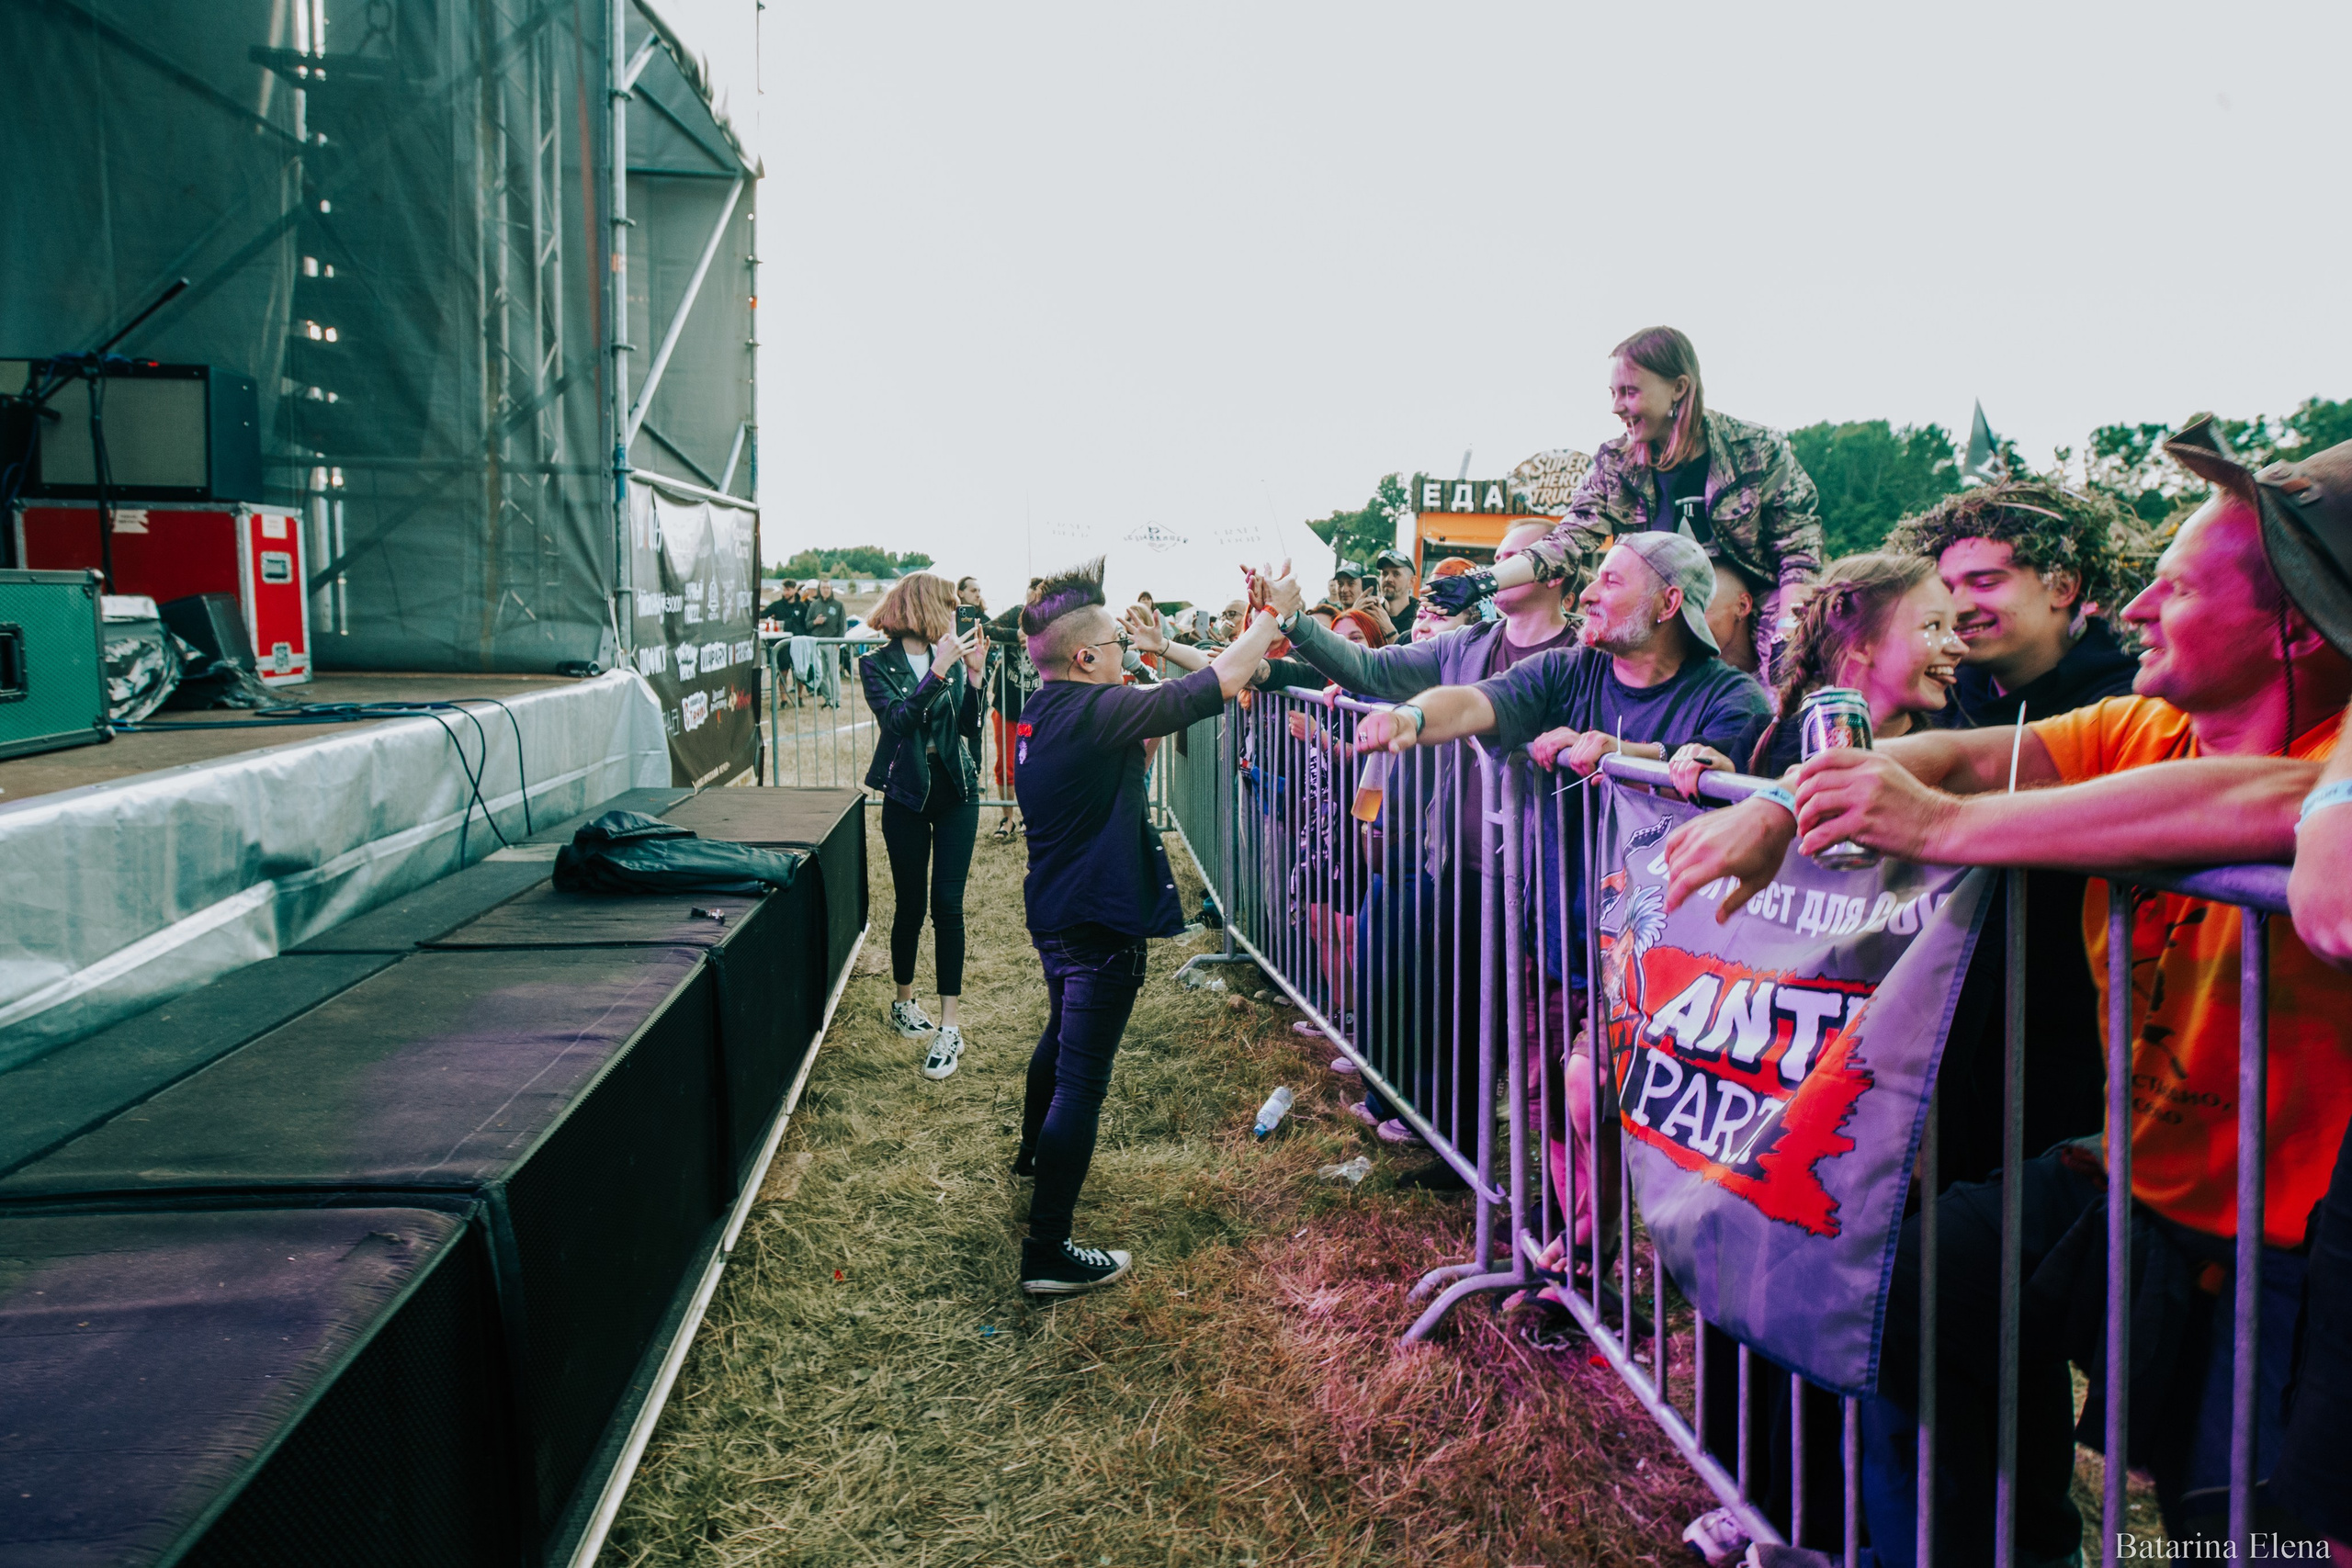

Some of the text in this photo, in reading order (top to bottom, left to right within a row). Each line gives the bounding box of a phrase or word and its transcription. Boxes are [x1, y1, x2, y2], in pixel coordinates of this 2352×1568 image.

[1532, 455, 1589, 477] SUPER
[1537, 470, 1583, 489] HERO
[1423, 483, 1505, 512] ЕДА
[1531, 487, 1574, 506] TRUC
[1795, 890, 1867, 938] ДЛЯ
[1647, 974, 1871, 1082] ANT
